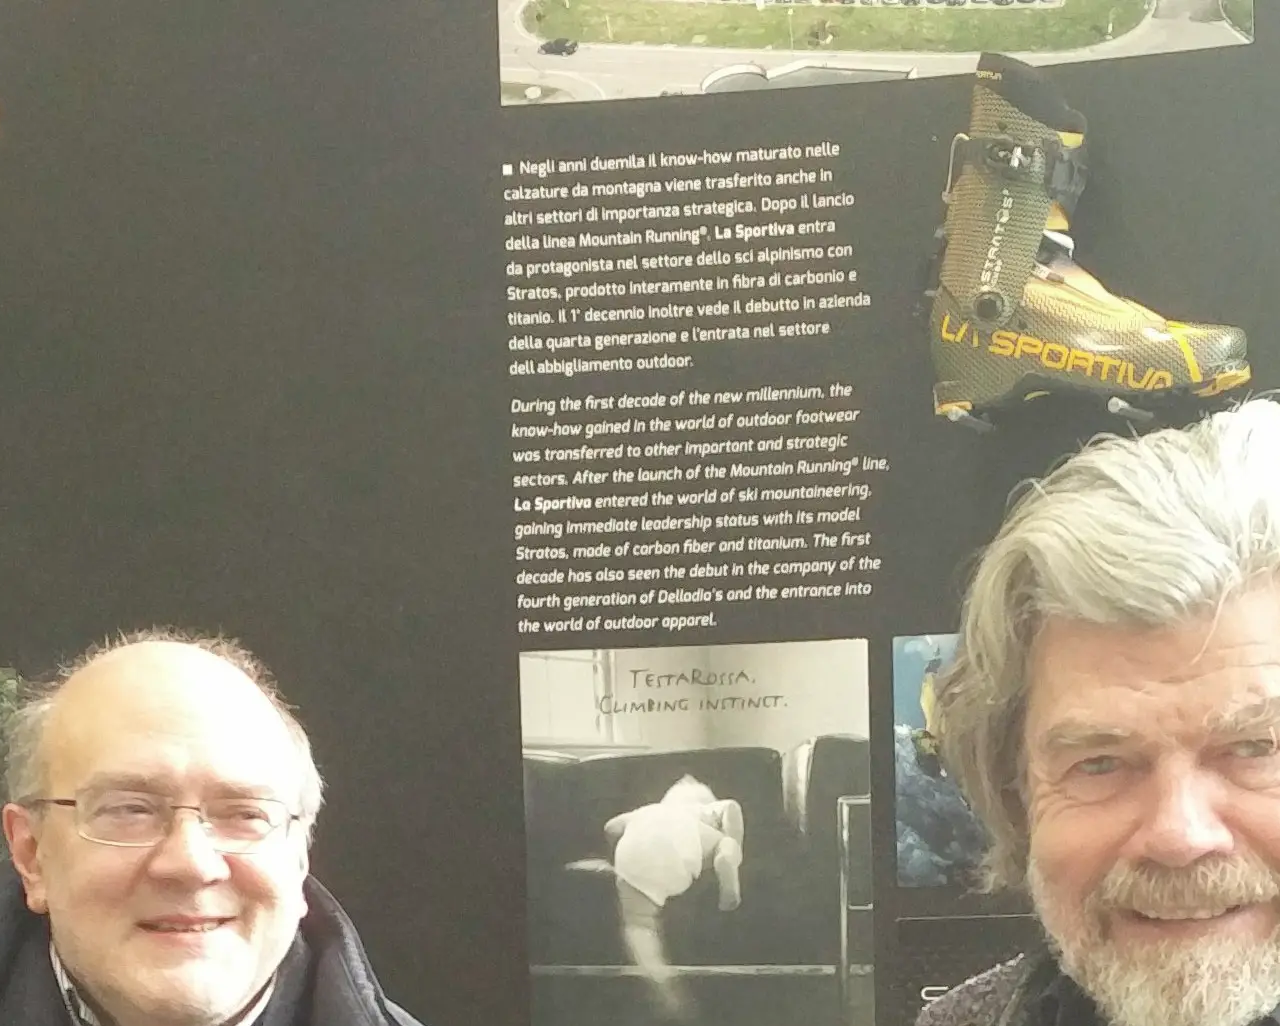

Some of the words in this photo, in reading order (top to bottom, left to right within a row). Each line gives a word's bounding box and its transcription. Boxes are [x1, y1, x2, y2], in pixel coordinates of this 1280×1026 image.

[519, 158, 555, 177] Negli
[558, 157, 587, 173] anni
[590, 153, 646, 171] duemila
[648, 152, 658, 168] il
[660, 149, 733, 167] know-how
[736, 145, 802, 162] maturato
[805, 142, 840, 158] nelle
[503, 185, 569, 201] calzature
[571, 182, 589, 198] da
[591, 181, 662, 198] montagna
[664, 177, 702, 193] viene
[704, 172, 772, 190] trasferito
[775, 169, 817, 185] anche
[820, 167, 833, 182] in
[504, 210, 533, 226] altri
[536, 208, 583, 225] settori
[586, 206, 599, 222] di
[601, 205, 680, 224] importanza
[761, 197, 797, 214] Dopo
[800, 194, 810, 209] il
[812, 192, 855, 209] lancio
[506, 261, 523, 276] da
[526, 257, 614, 279] protagonista
[616, 255, 639, 270] nel
[641, 254, 693, 270] settore
[696, 250, 731, 266] dello
[734, 249, 754, 264] sci
[757, 246, 824, 266] alpinismo
[827, 245, 853, 258] con
[988, 330, 1173, 391] SPORTIVA
[511, 398, 556, 415] During
[559, 396, 582, 411] the
[585, 394, 615, 410] first
[617, 392, 667, 409] decade
[669, 390, 686, 406] of
[688, 390, 711, 405] the
[713, 391, 743, 404] new
[829, 382, 853, 398] the
[511, 421, 583, 438] know-how
[585, 418, 631, 439] gained
[633, 419, 646, 433] in
[649, 416, 672, 432] the
[675, 414, 716, 431] world
[717, 413, 734, 429] of
[736, 411, 793, 428] outdoor
[795, 409, 861, 425] footwear
[514, 497, 531, 512] La
[534, 495, 592, 515] Sportiva
[594, 491, 649, 509] entered
[651, 491, 674, 506] the
[676, 488, 718, 505] world
[719, 487, 736, 503] of
[738, 486, 759, 502] ski
[517, 593, 561, 609] fourth
[563, 592, 637, 611] generation
[639, 589, 656, 605] of
[726, 585, 753, 602] and
[755, 585, 779, 600] the
[780, 585, 842, 599] entrance
[844, 581, 872, 596] into
[599, 695, 689, 715] CLIMBING
